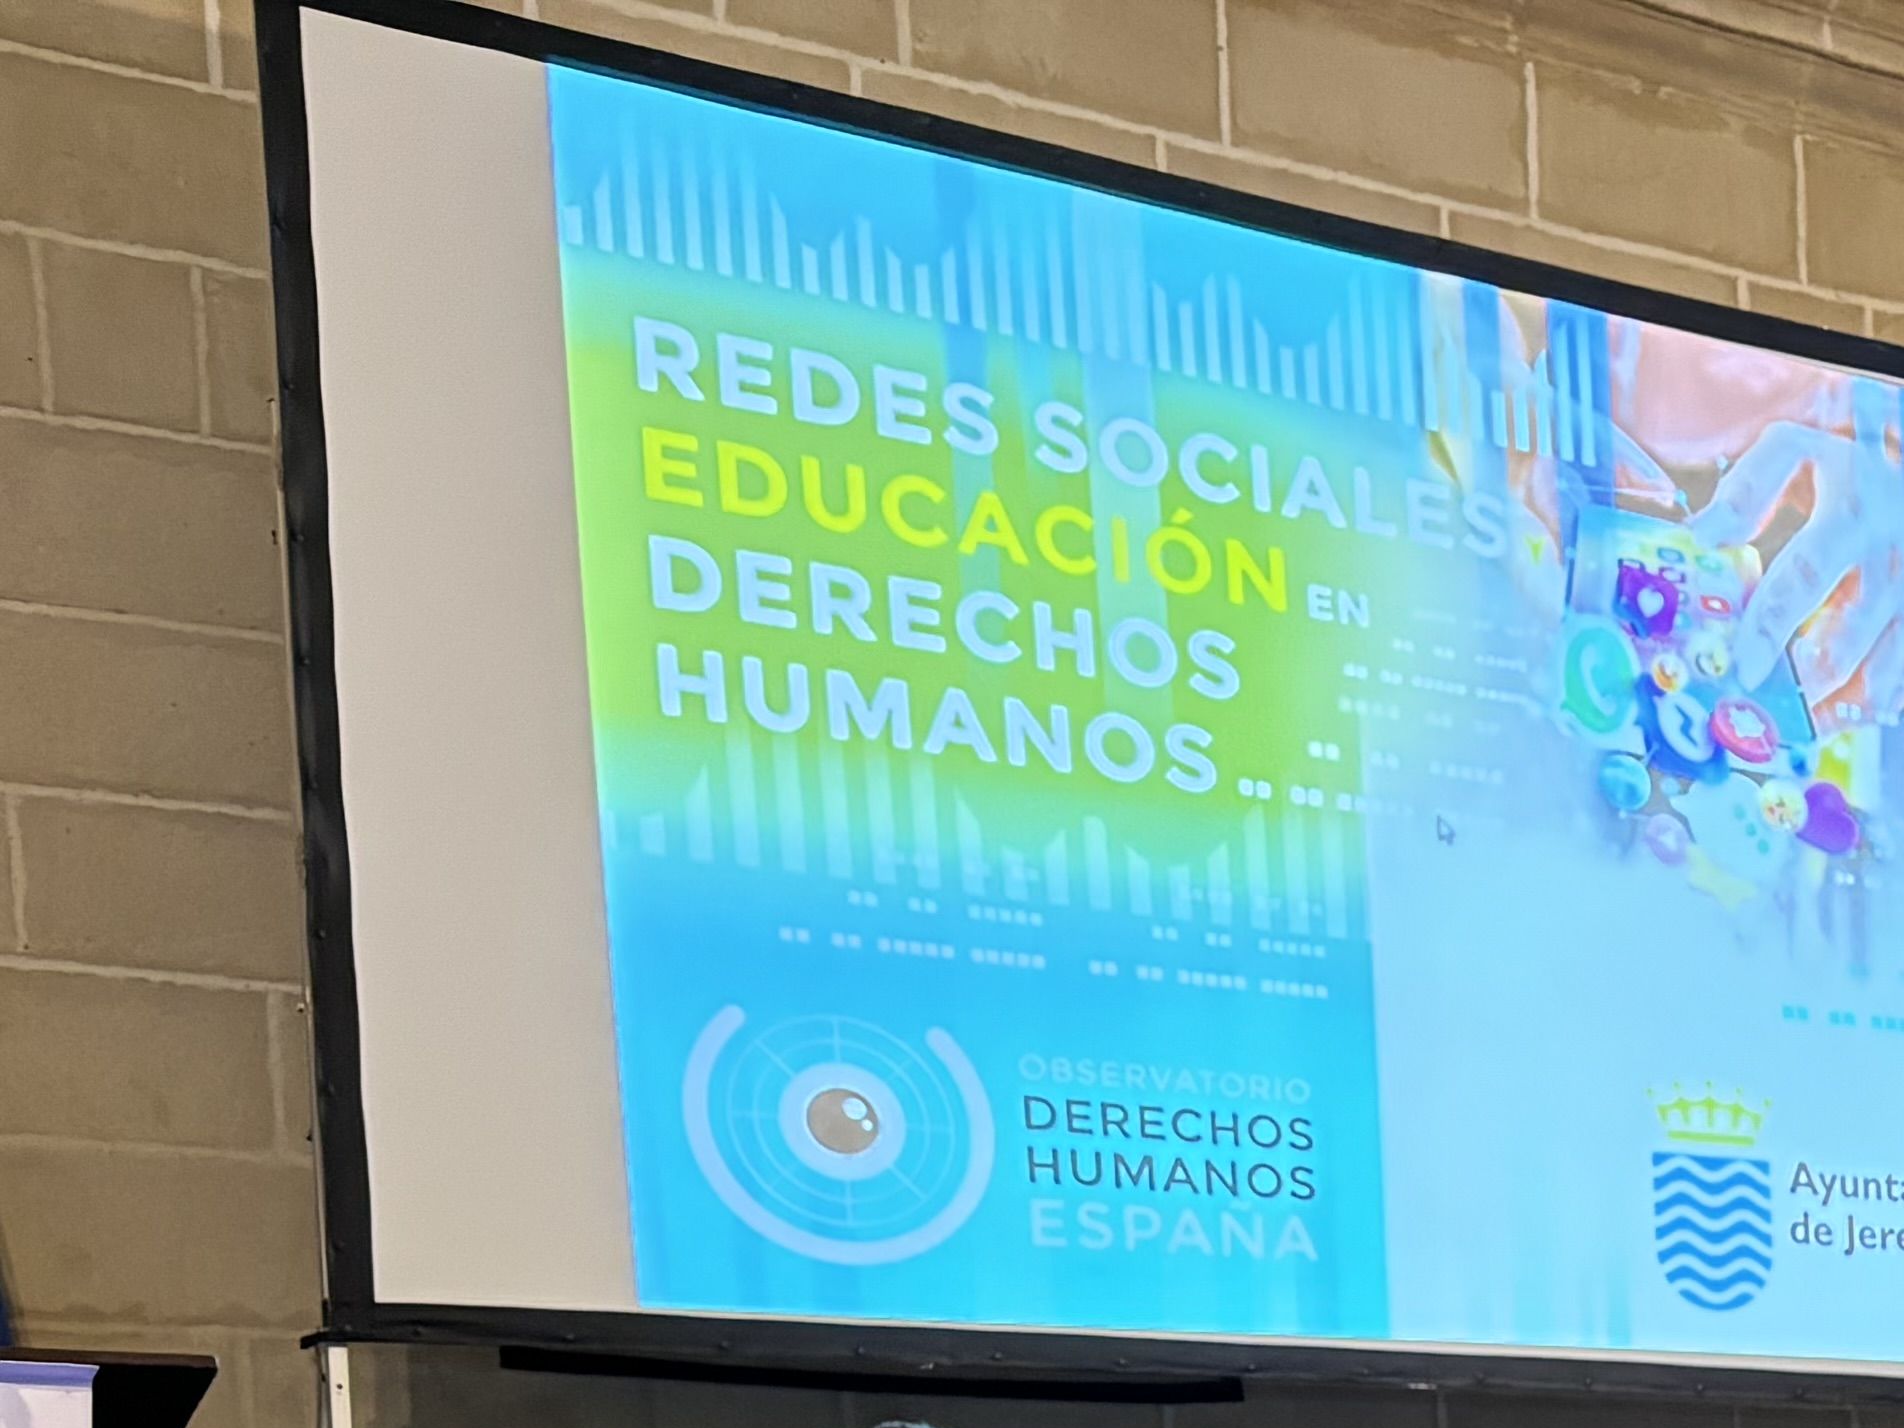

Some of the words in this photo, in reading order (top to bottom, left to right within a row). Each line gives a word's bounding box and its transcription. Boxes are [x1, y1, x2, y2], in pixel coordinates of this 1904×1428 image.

[632, 313, 998, 457] REDES
[1034, 400, 1508, 560] SOCIALES
[641, 425, 1288, 614] EDUCACIÓN
[1306, 581, 1371, 629] EN
[648, 534, 1241, 699] DERECHOS
[656, 643, 1219, 795] HUMANOS
[1019, 1053, 1312, 1104] OBSERVATORIO
[1023, 1095, 1314, 1150] DERECHOS
[1028, 1146, 1317, 1199] HUMANOS
[1030, 1199, 1320, 1260] ESPAÑA
[1790, 1212, 1833, 1246] de
